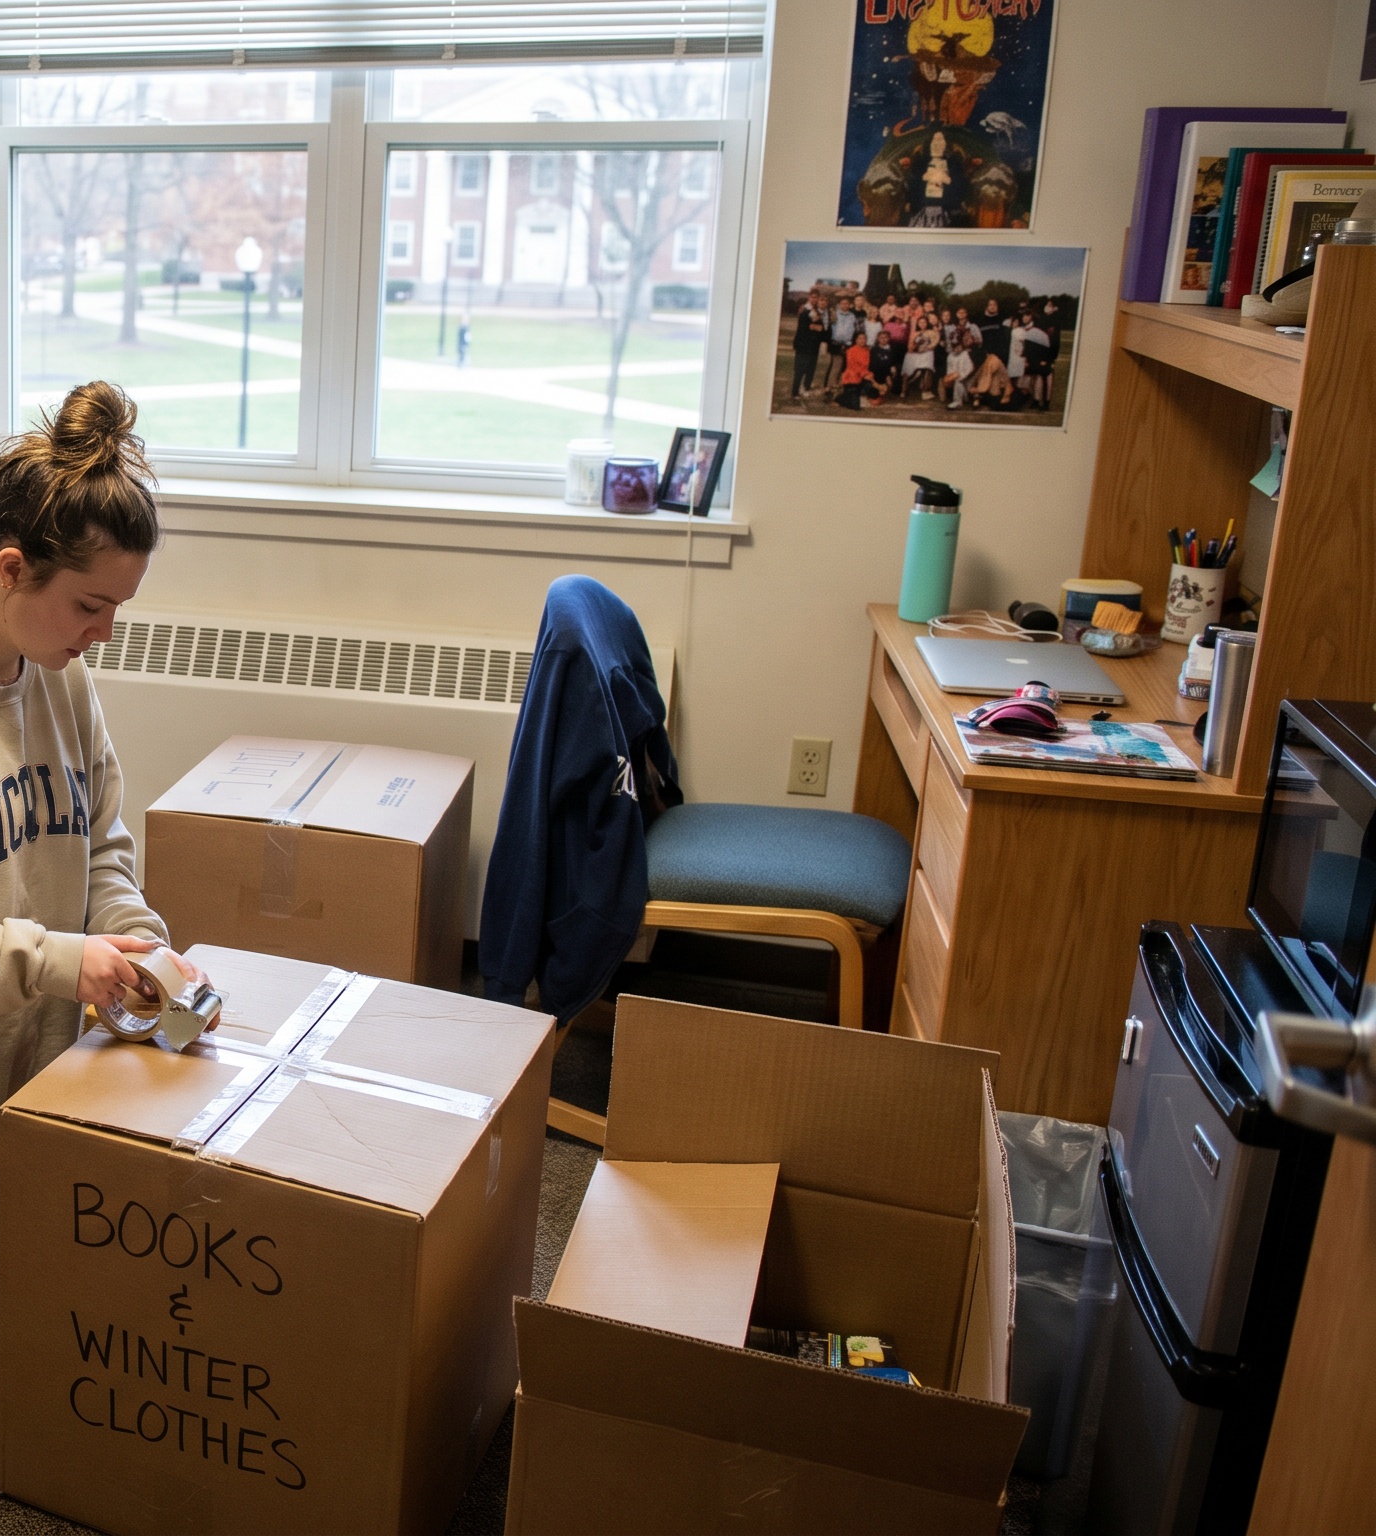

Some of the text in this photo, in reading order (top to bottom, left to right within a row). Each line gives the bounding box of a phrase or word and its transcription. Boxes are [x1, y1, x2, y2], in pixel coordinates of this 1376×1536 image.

[73, 1182, 283, 1296] BOOKS
[70, 1310, 281, 1421] WINTER
[169, 1284, 194, 1336] &
[70, 1376, 307, 1490] CLOTHES
